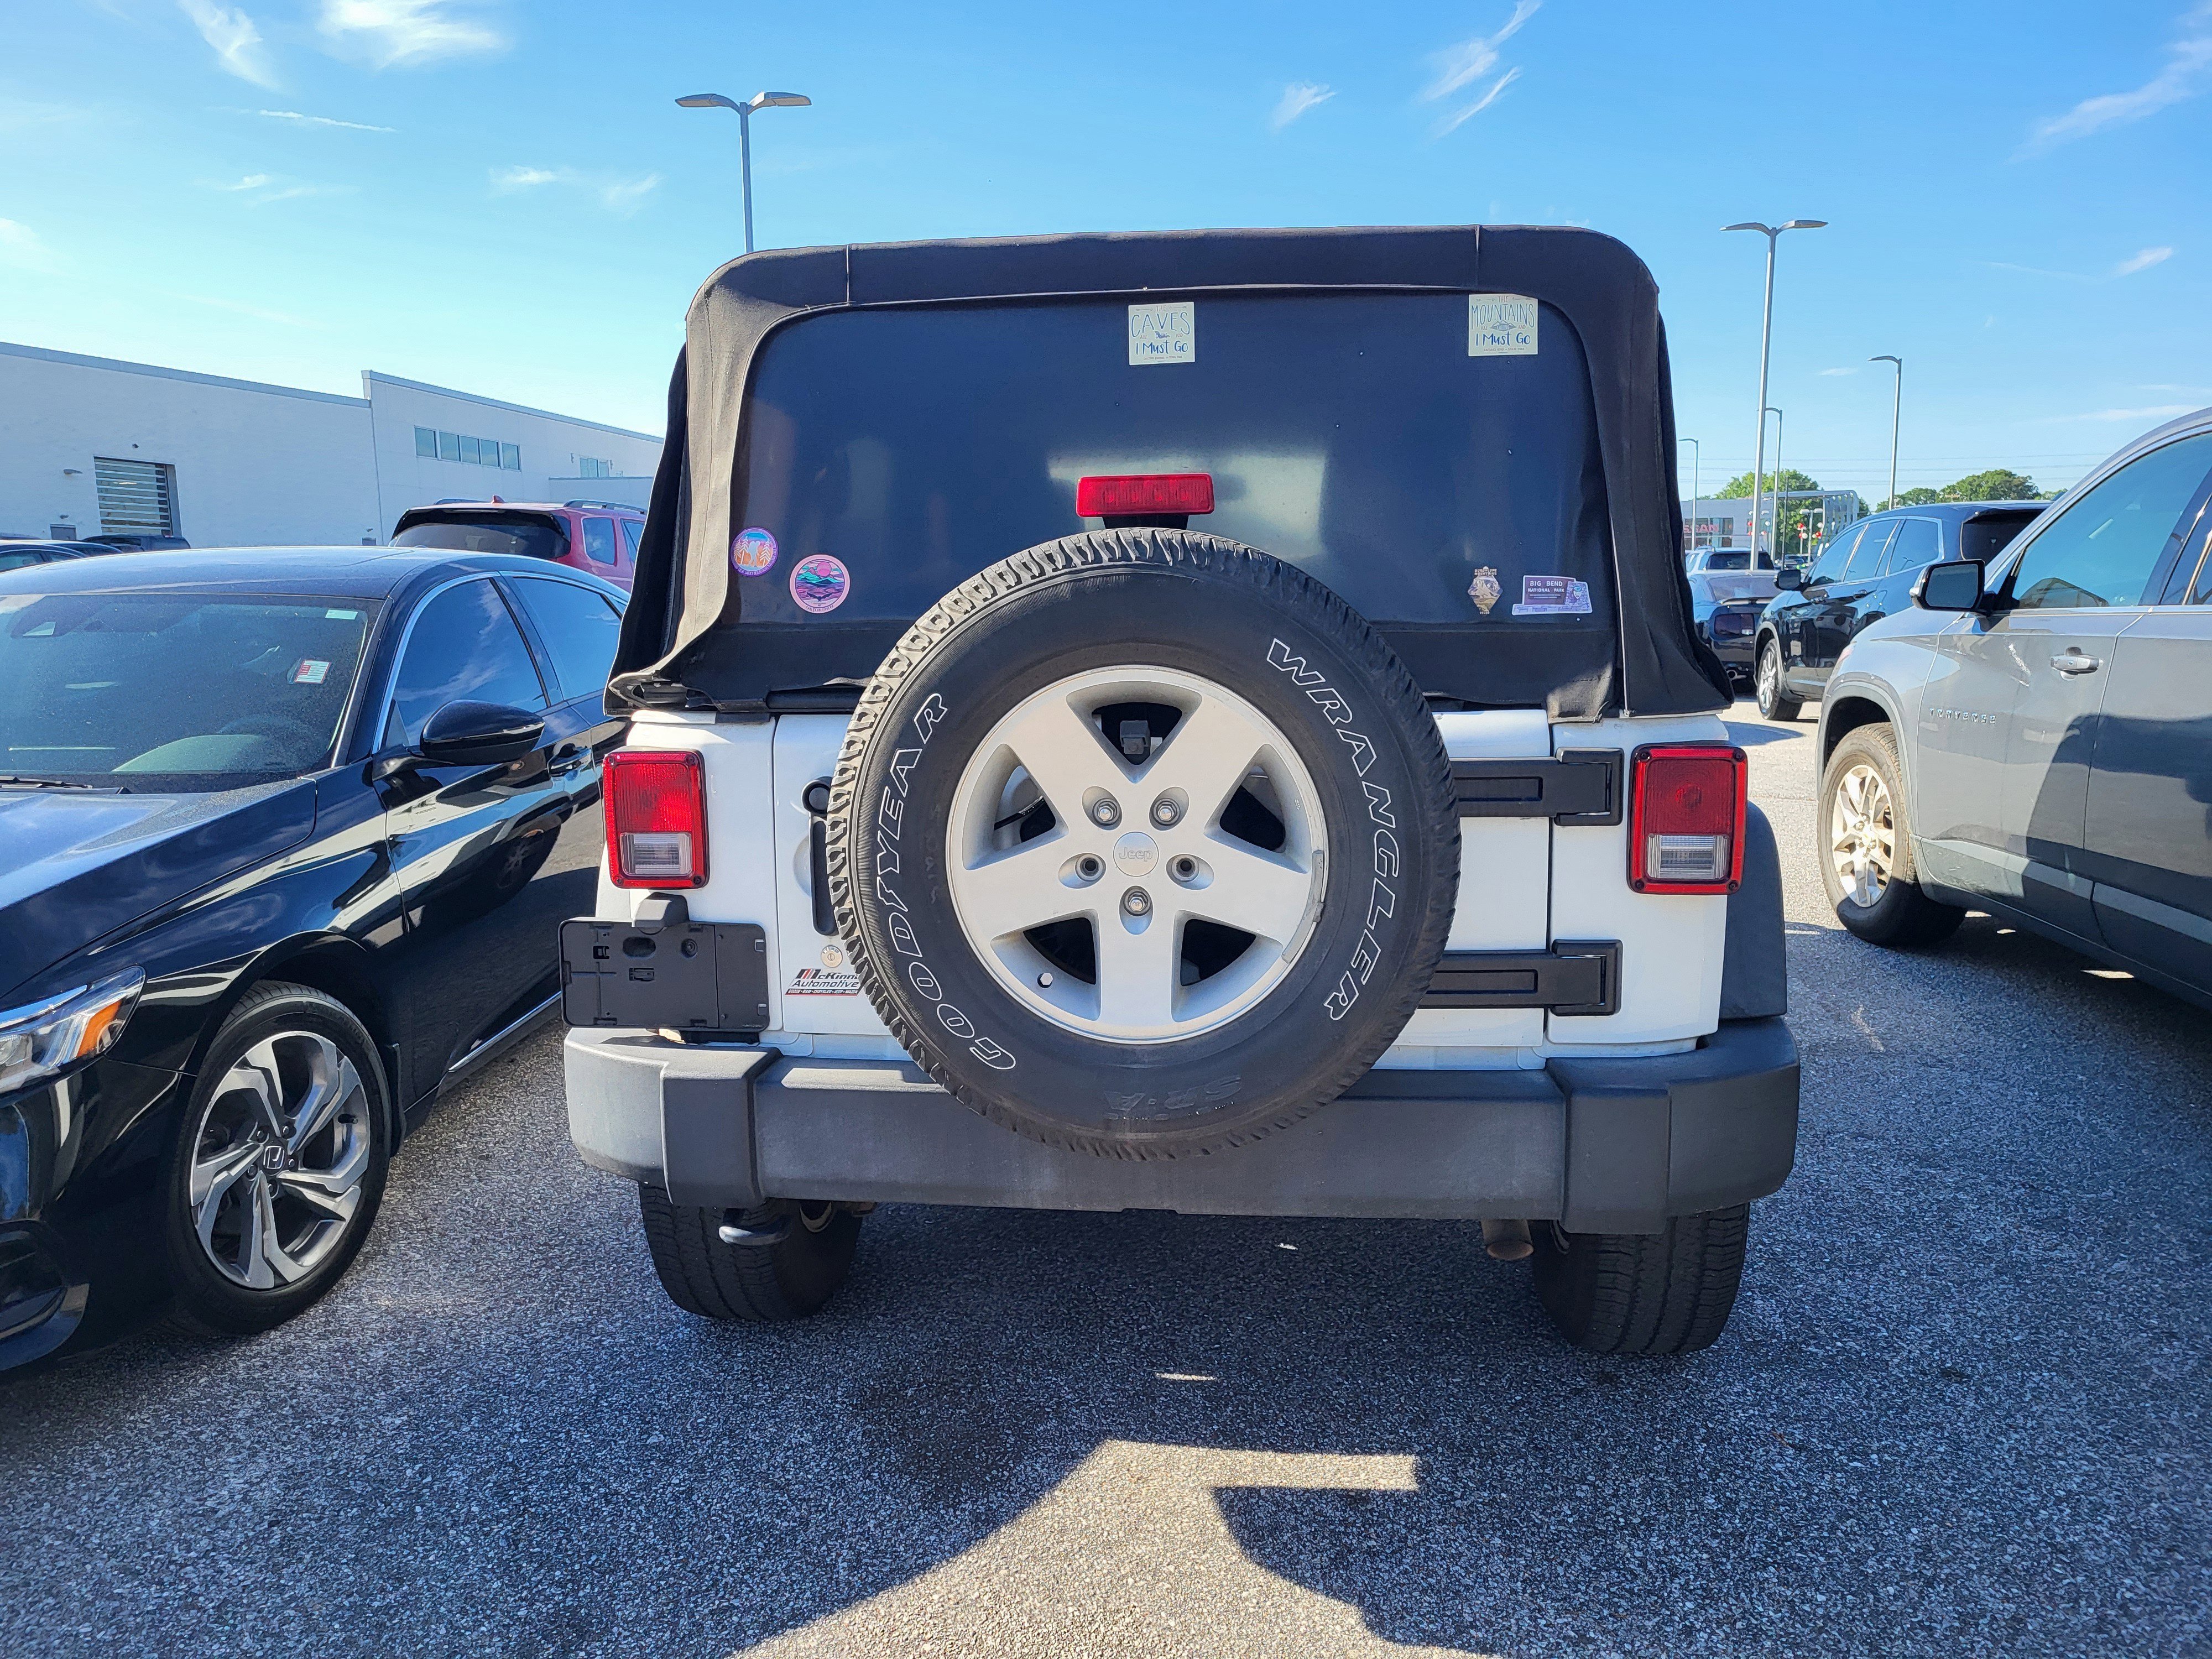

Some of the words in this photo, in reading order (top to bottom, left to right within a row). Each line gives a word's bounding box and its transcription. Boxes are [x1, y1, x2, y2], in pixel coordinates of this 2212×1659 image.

[1131, 312, 1190, 337] CAVES
[1471, 303, 1535, 330] MOUNTAINS
[1136, 342, 1138, 354] I
[1142, 340, 1170, 354] Must
[1476, 333, 1478, 346] I
[1483, 331, 1512, 346] Must
[1929, 707, 1996, 724] TRAVERSE
[1267, 638, 1399, 1021] WRANGLER
[1118, 847, 1153, 862] Jeep
[876, 693, 1016, 1070] GOODYEAR
[791, 979, 859, 988] Automotive
